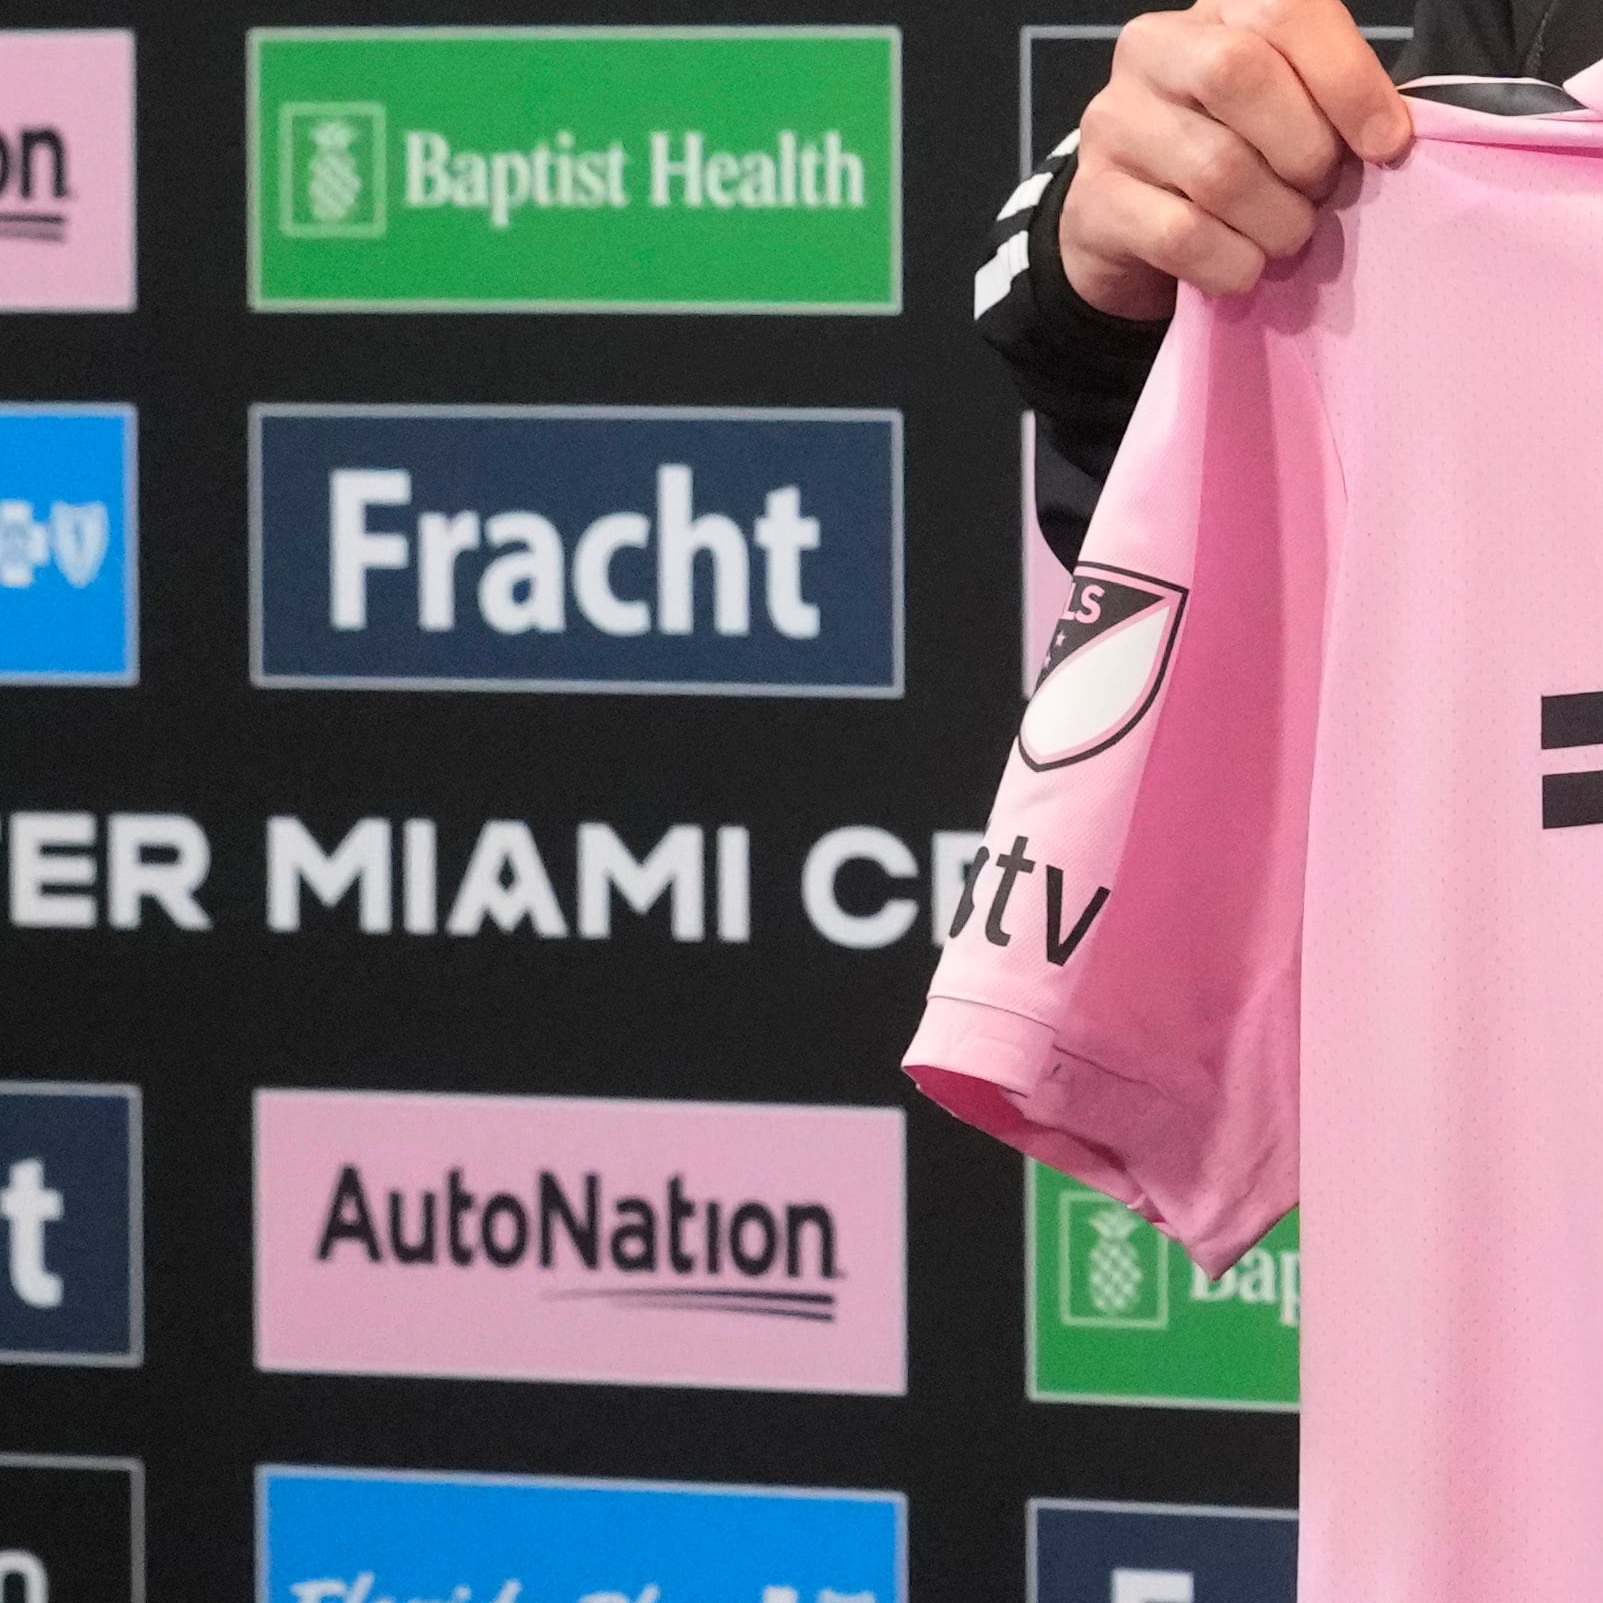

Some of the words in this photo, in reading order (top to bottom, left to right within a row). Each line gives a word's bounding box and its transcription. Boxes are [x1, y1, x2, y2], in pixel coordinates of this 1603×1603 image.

[403, 130, 629, 229] Baptist
[650, 129, 866, 210] Health
[329, 463, 821, 640] Fracht
[266, 815, 751, 943] MIAMI
[984, 834, 1112, 968] tv
[313, 1164, 840, 1281] AutoNation
